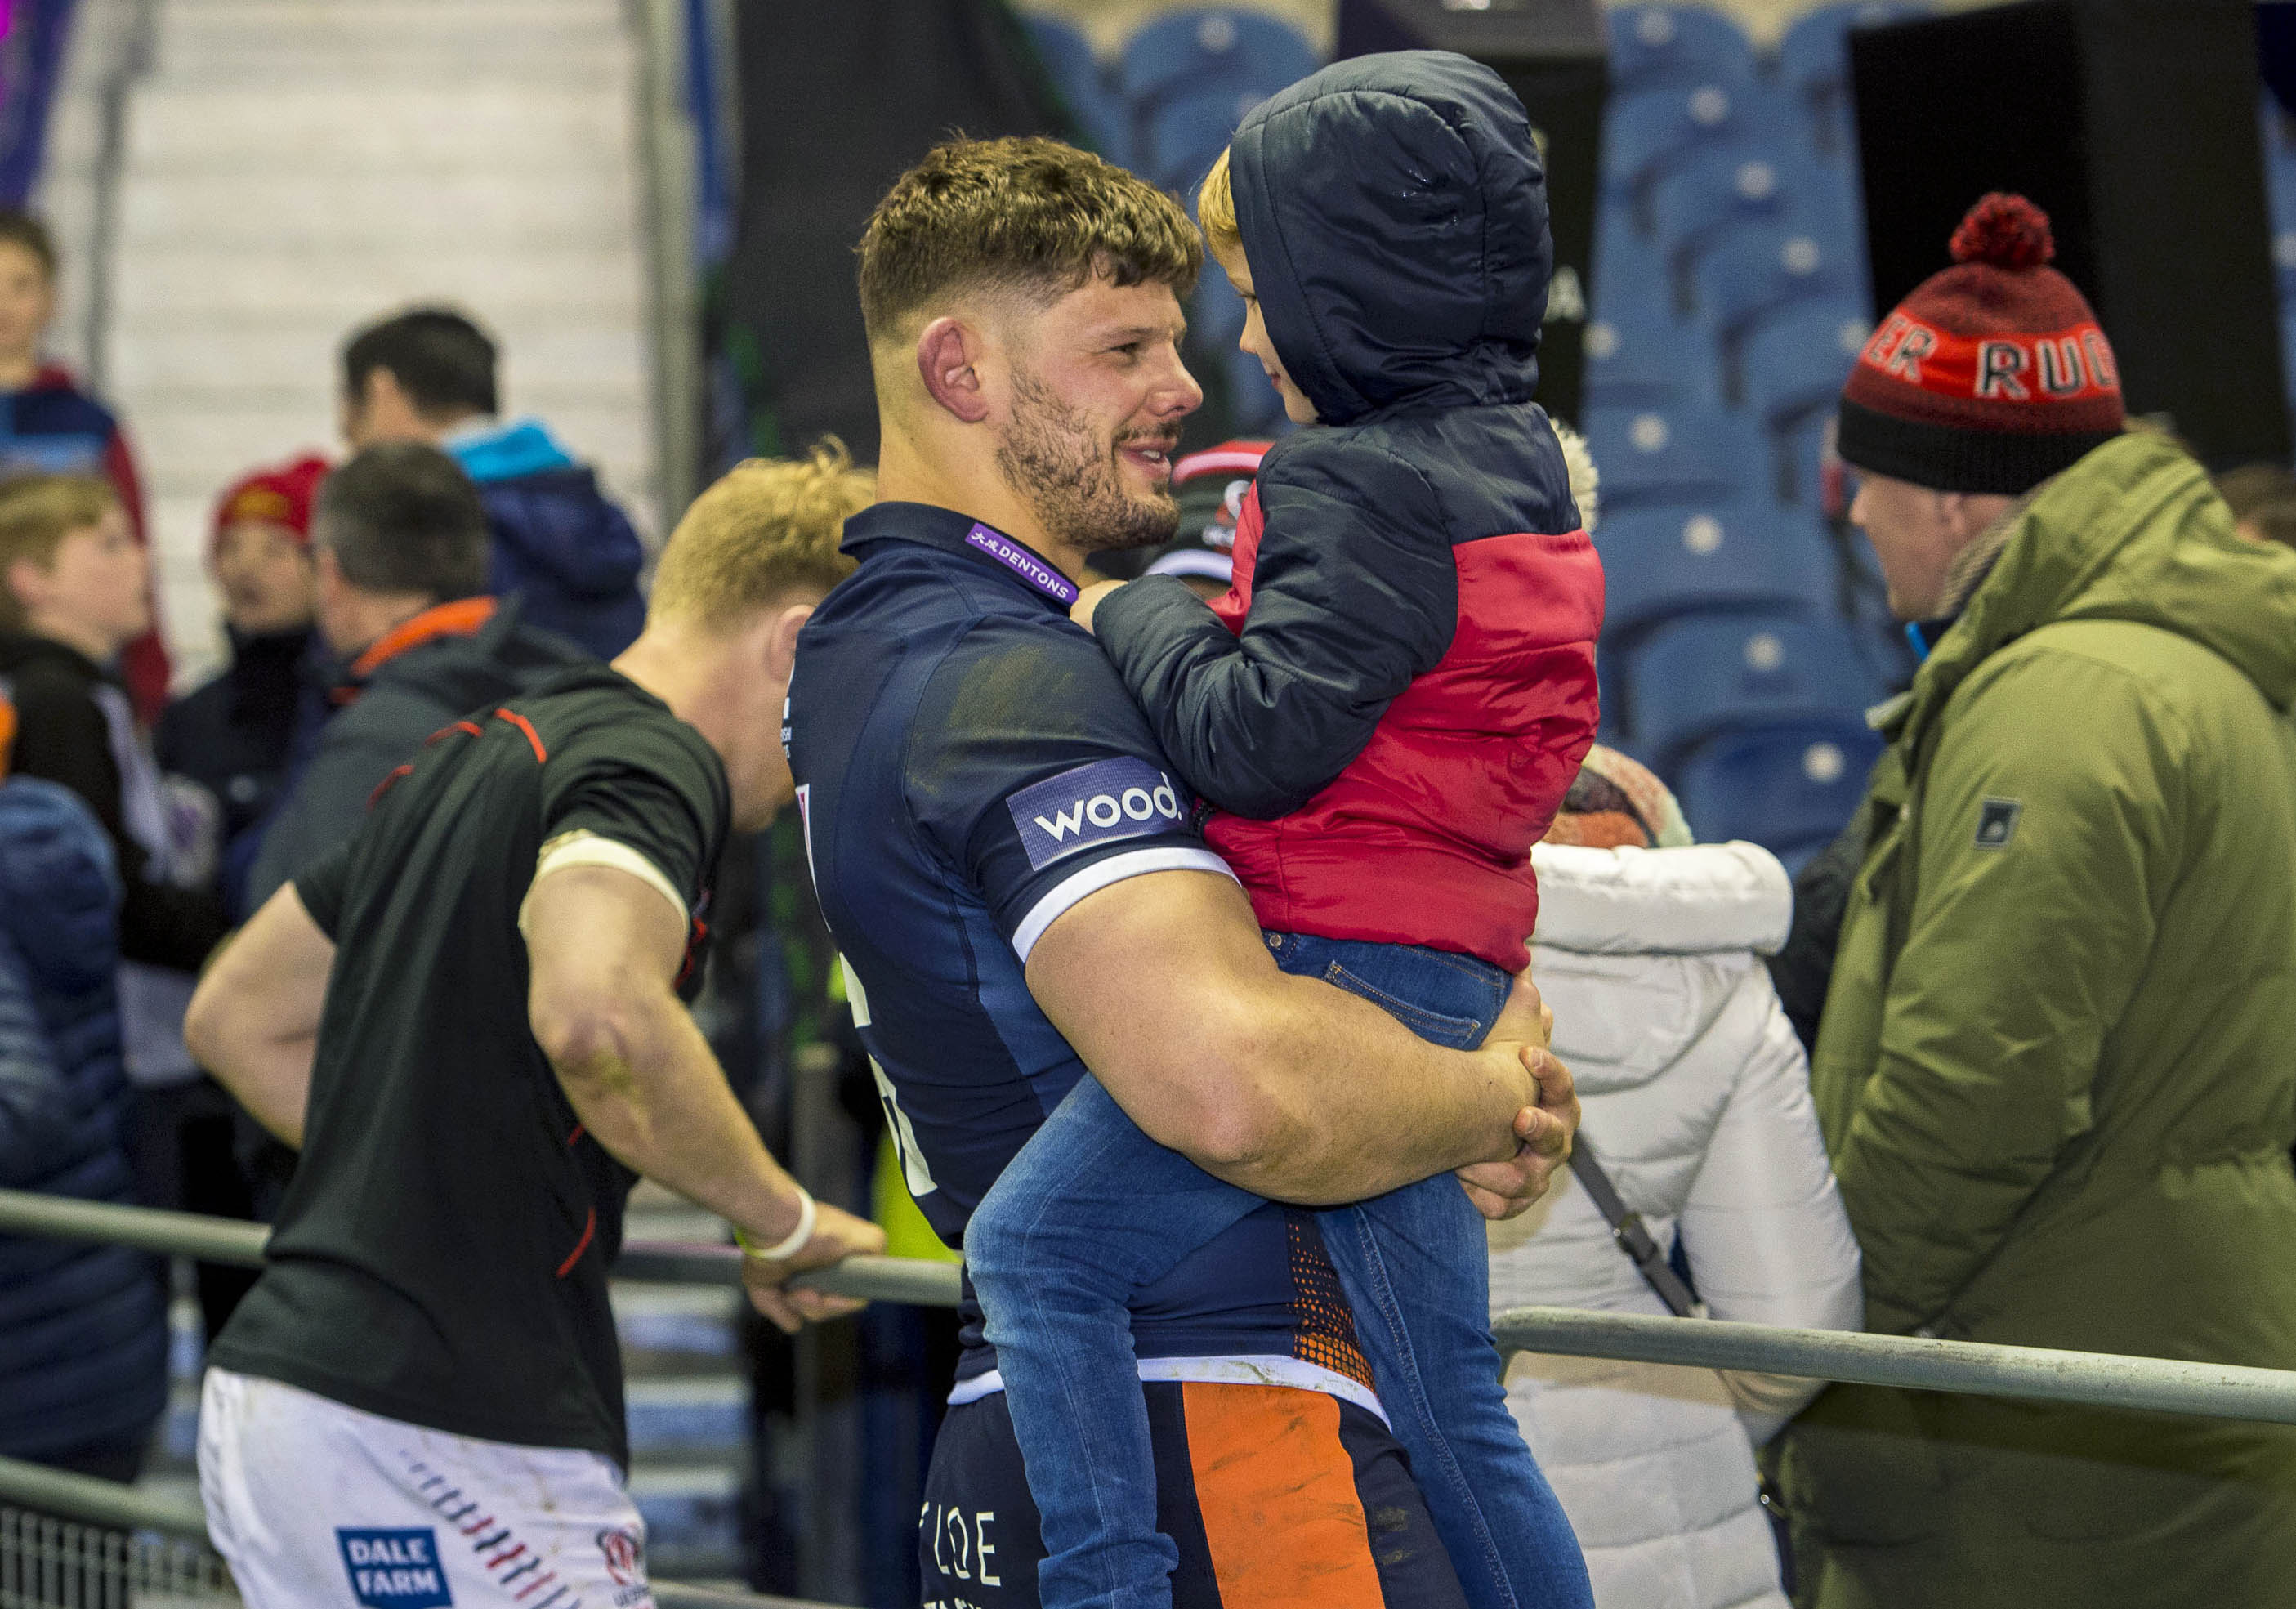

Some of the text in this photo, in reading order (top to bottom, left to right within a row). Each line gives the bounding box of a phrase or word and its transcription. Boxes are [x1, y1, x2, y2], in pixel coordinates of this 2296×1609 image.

[998, 545, 1069, 598] DENTONS
[1033, 771, 1182, 842] wood.
[346, 1538, 431, 1567] DALE
[918, 1501, 1002, 1586] LOE
[355, 1568, 440, 1596] FARM
